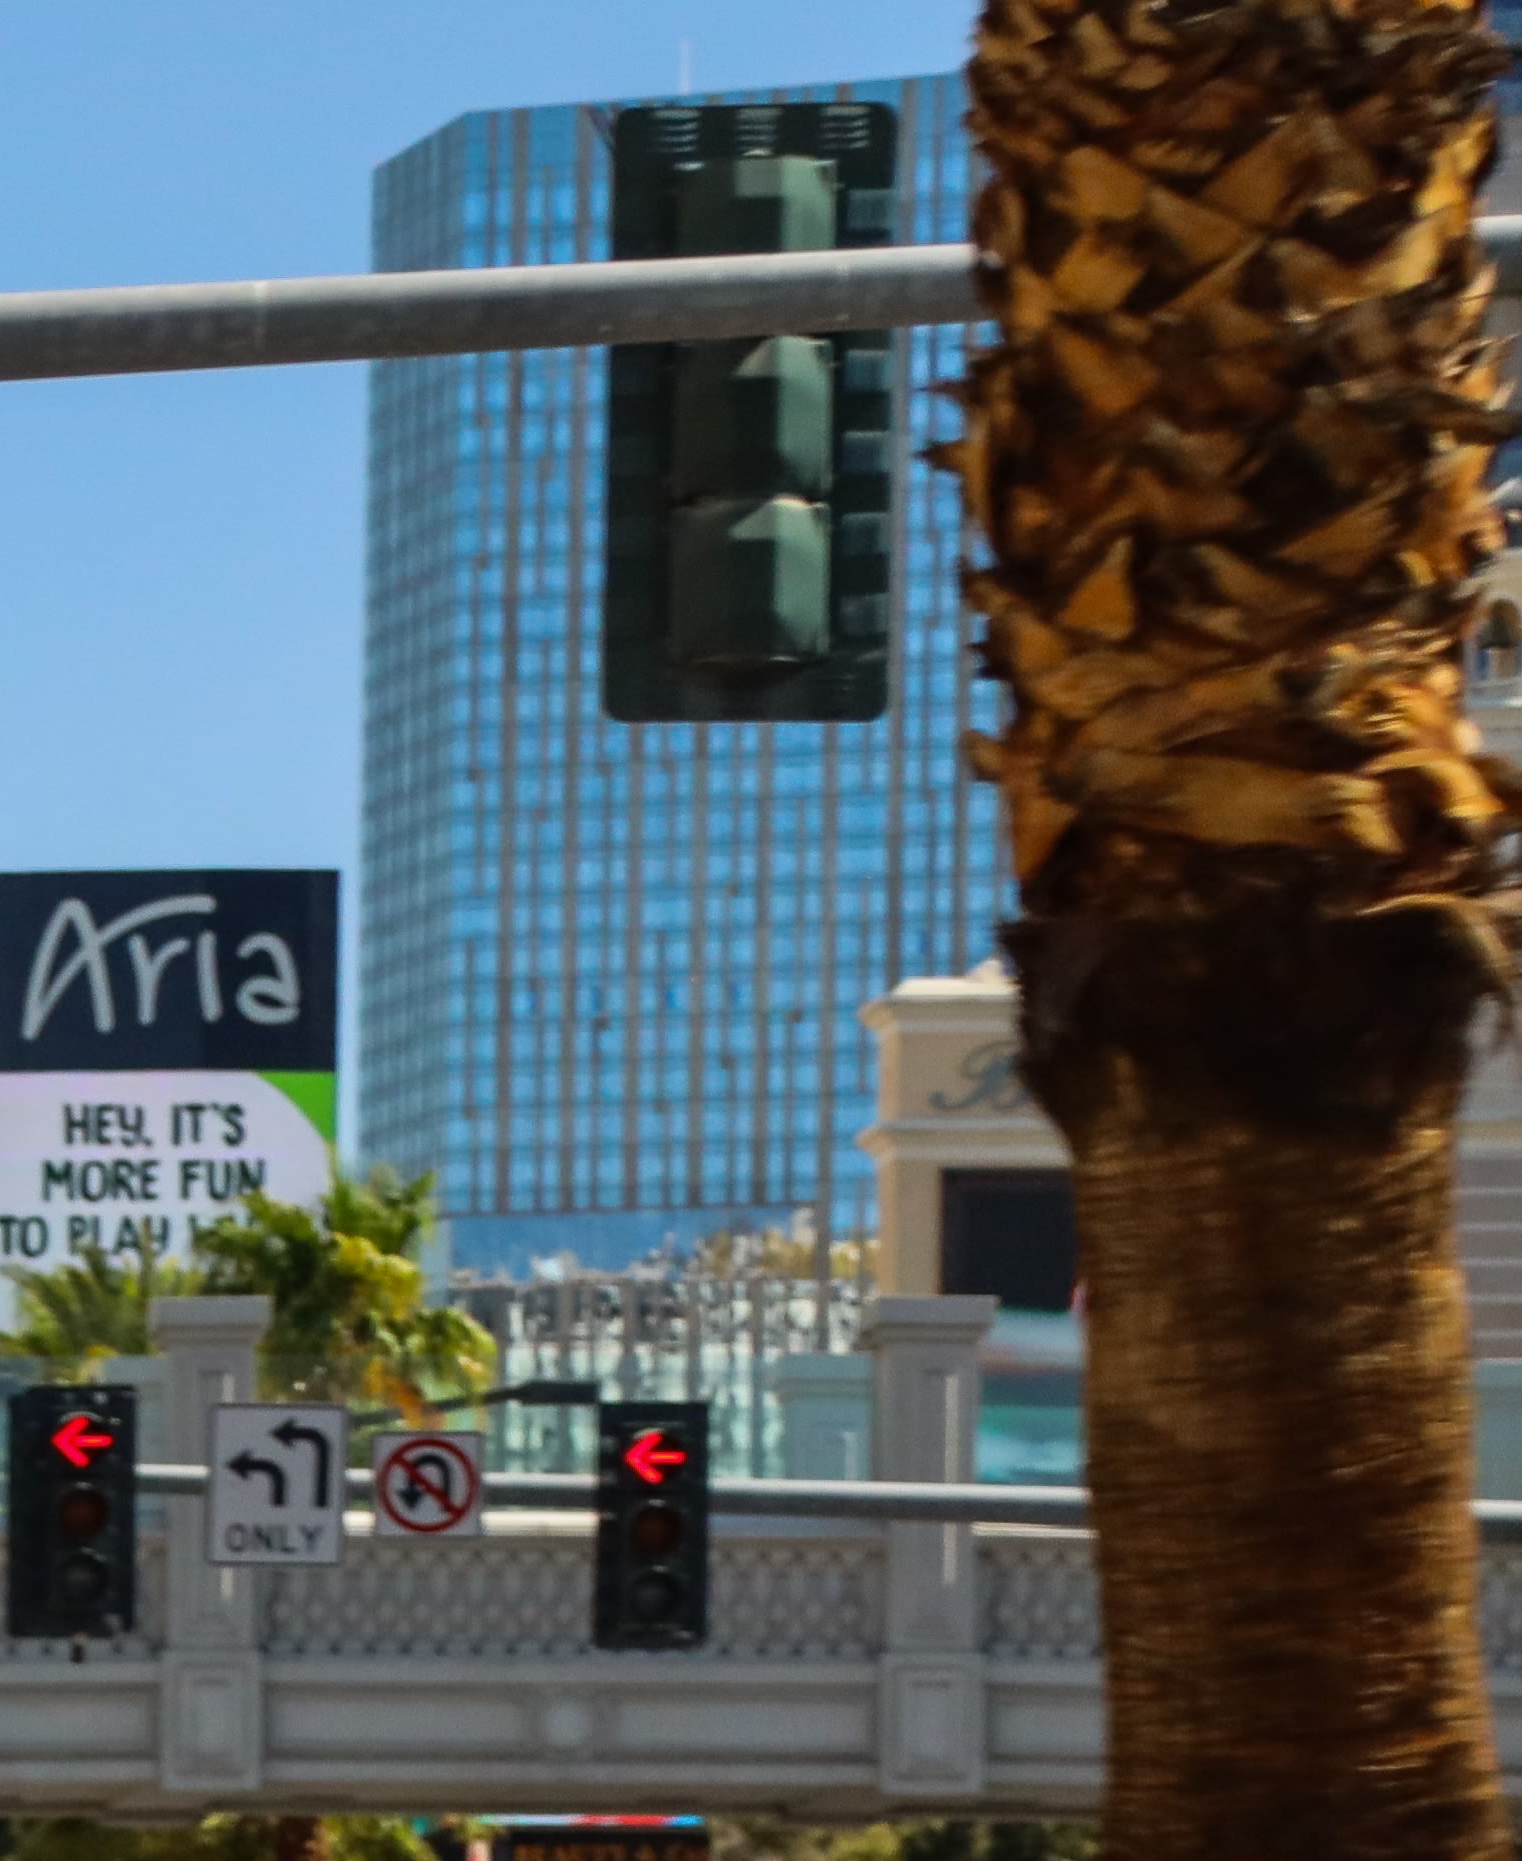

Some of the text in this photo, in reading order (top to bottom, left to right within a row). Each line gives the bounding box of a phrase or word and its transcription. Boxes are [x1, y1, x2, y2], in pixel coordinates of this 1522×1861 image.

[21, 895, 300, 1040] Aria
[170, 1104, 246, 1146] IT'S
[41, 1159, 267, 1201] MORE FUN
[68, 1215, 171, 1258] PLAY
[224, 1522, 324, 1554] ONLY
